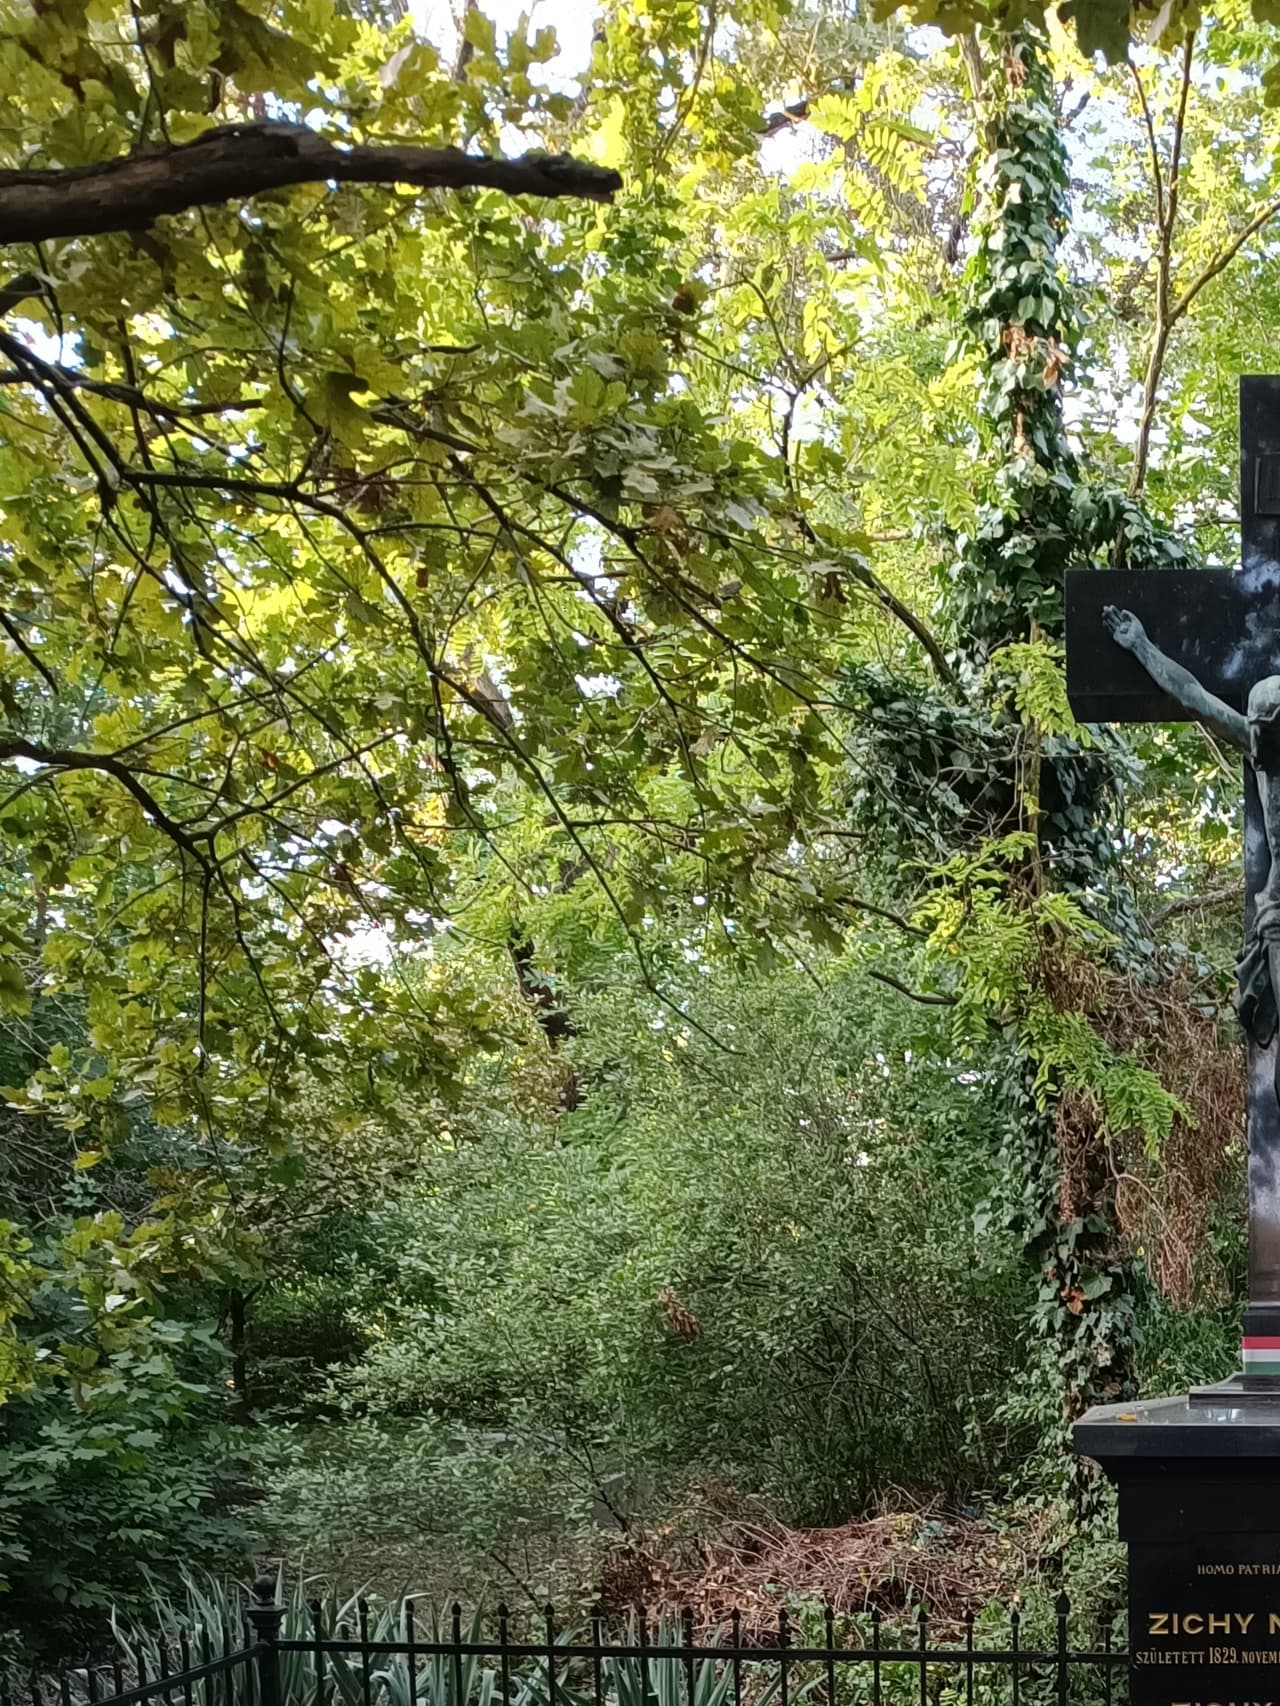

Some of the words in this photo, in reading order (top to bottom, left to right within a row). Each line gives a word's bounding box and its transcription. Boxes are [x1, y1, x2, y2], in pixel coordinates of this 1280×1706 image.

[1197, 1564, 1235, 1575] HOMO
[1148, 1612, 1255, 1635] ZICHY
[1135, 1647, 1206, 1665] SZÜLETETT
